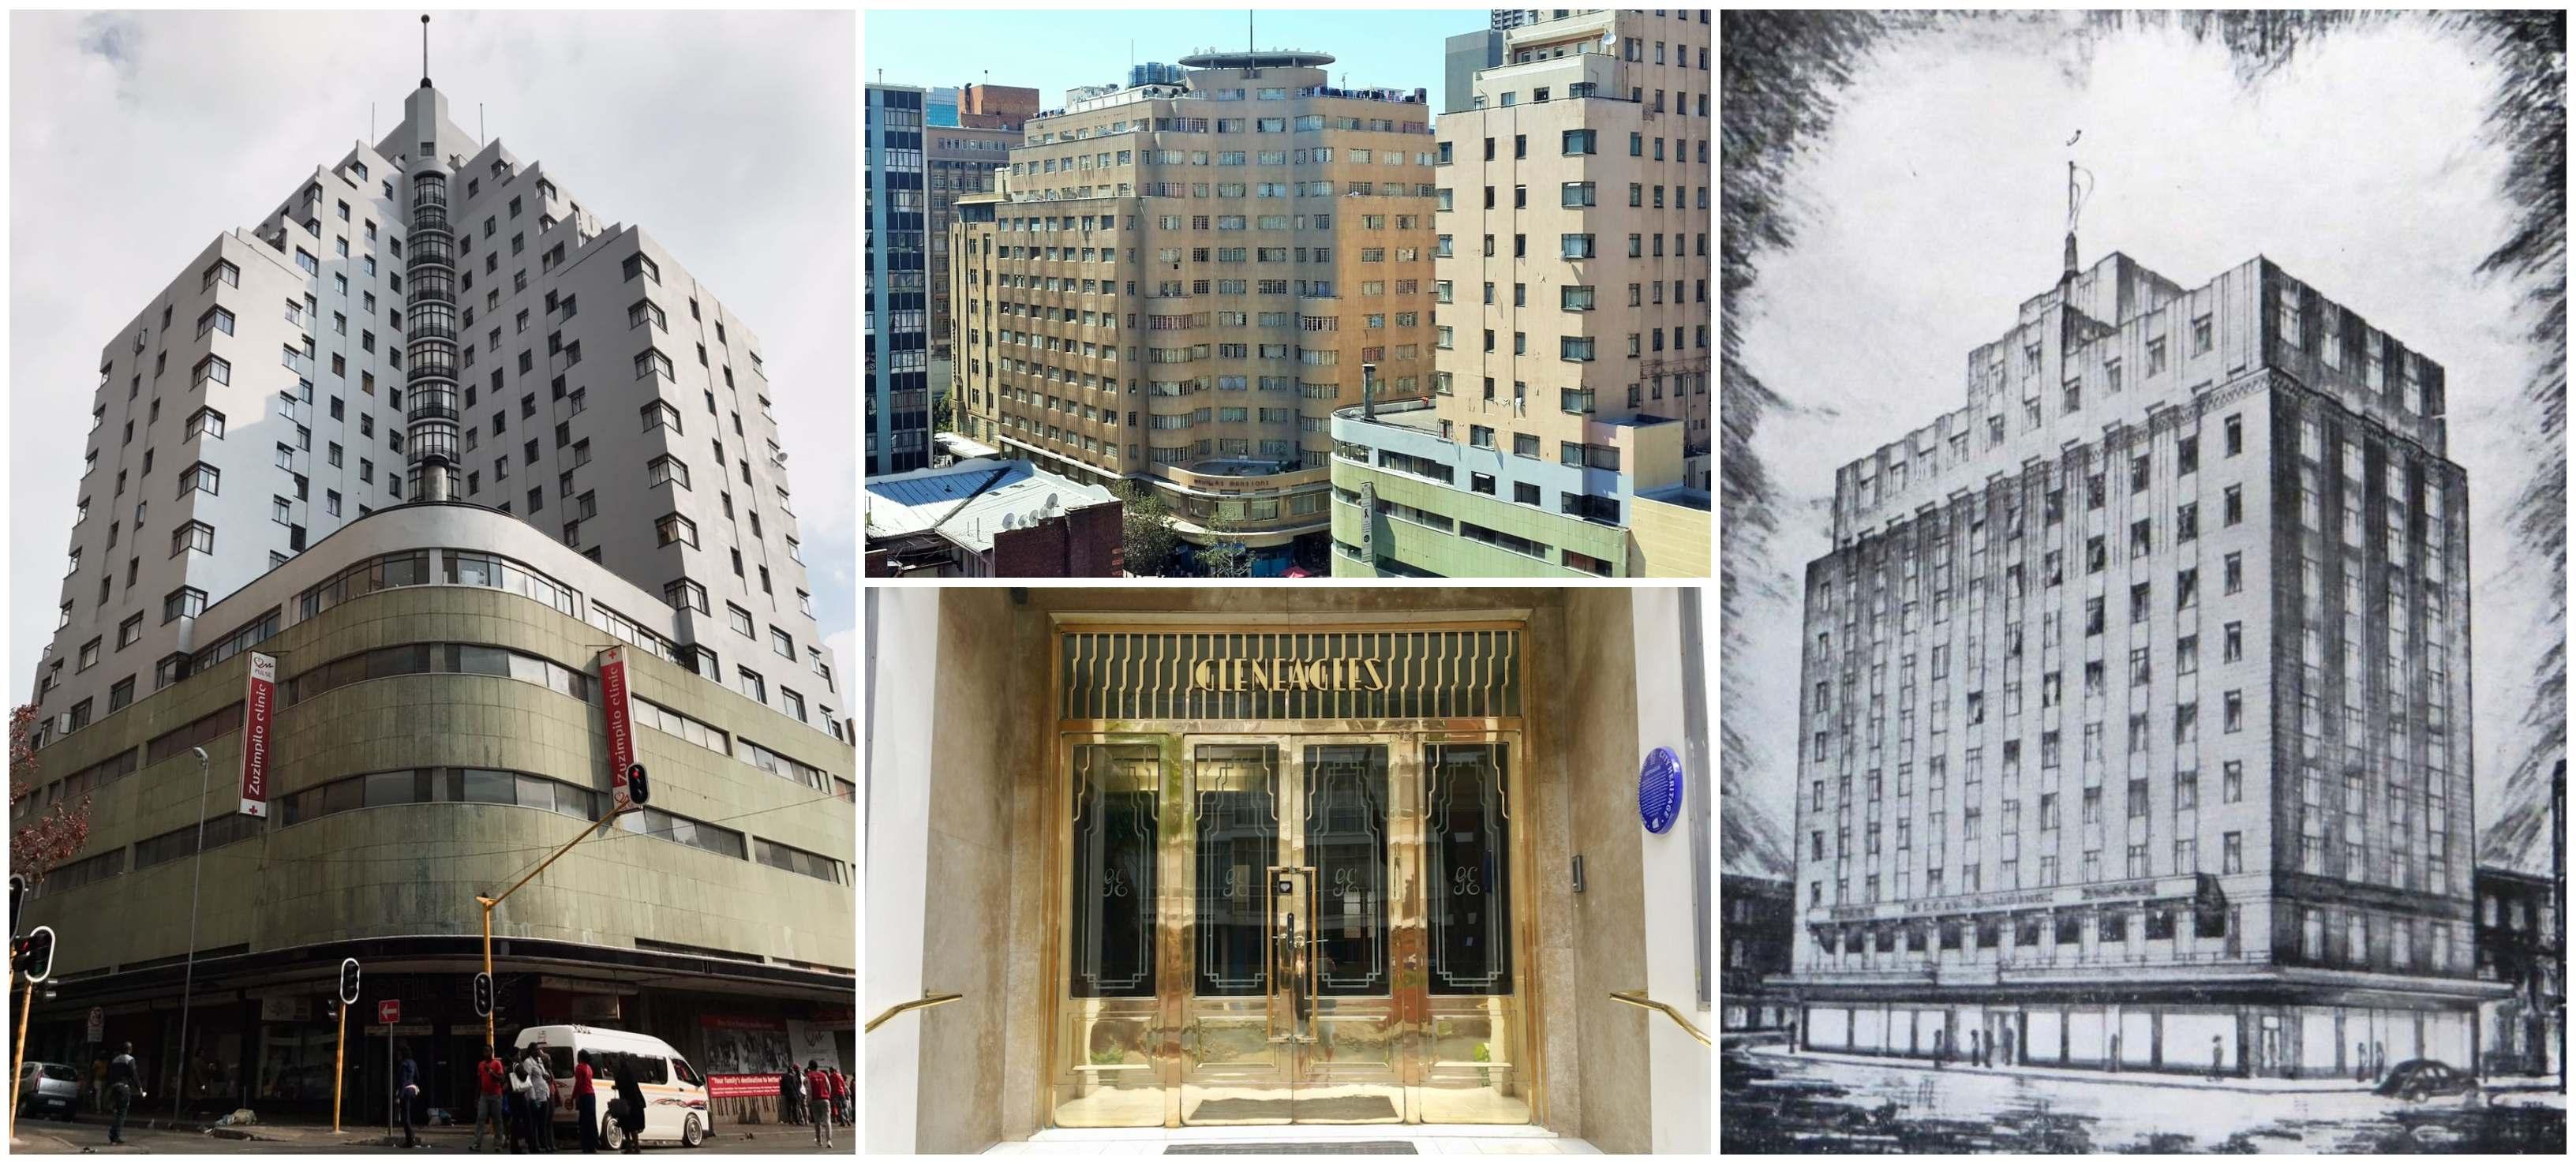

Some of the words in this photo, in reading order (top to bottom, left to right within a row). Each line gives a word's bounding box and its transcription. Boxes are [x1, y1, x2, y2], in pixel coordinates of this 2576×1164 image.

[608, 667, 619, 706] clinic
[1195, 657, 1384, 692] GLENEAGLES
[254, 683, 267, 721] clinic
[249, 725, 264, 795] Zuzimpilo
[613, 709, 627, 784] Zuzimpilo
[1659, 750, 1671, 765] CITY
[1664, 766, 1675, 818] HERITAGE
